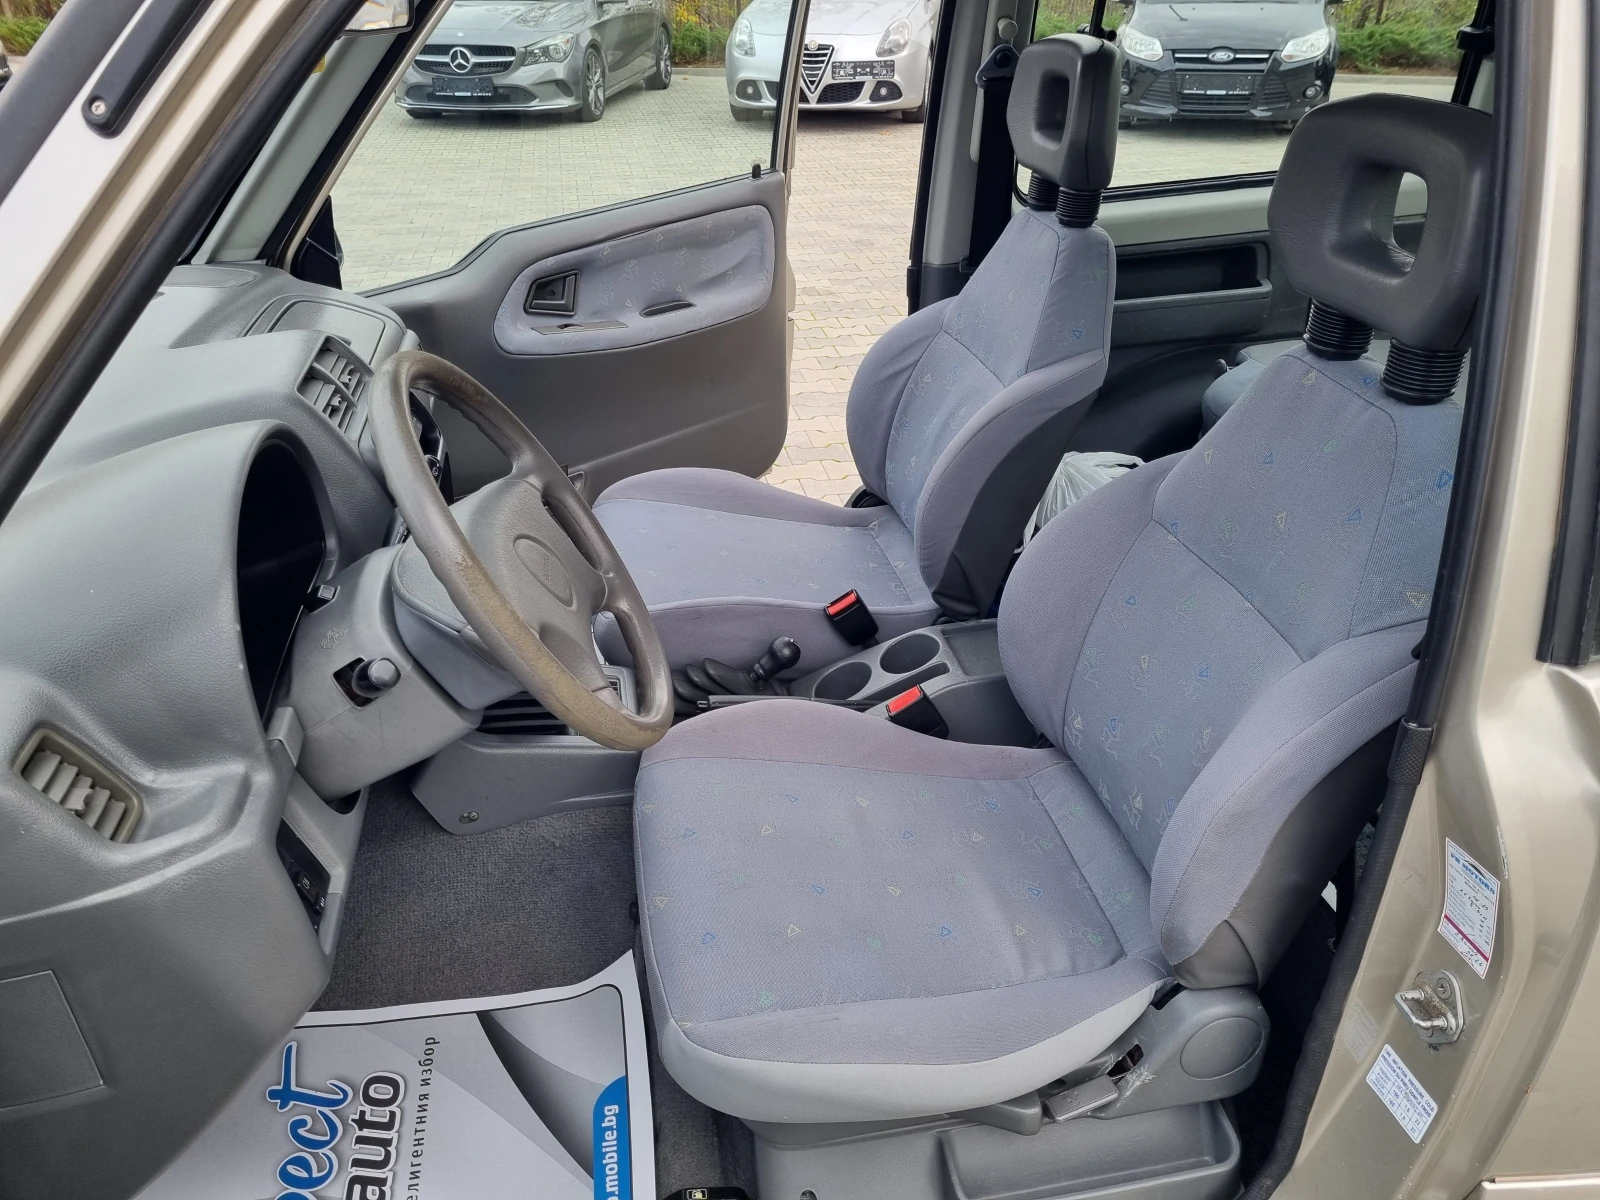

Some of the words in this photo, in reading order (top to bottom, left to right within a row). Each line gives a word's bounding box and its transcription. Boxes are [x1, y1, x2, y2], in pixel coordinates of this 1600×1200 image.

[1462, 863, 1495, 894] MOTORS
[418, 1036, 440, 1087] избор
[1424, 1099, 1434, 1112] COLD
[345, 1073, 402, 1200] auto
